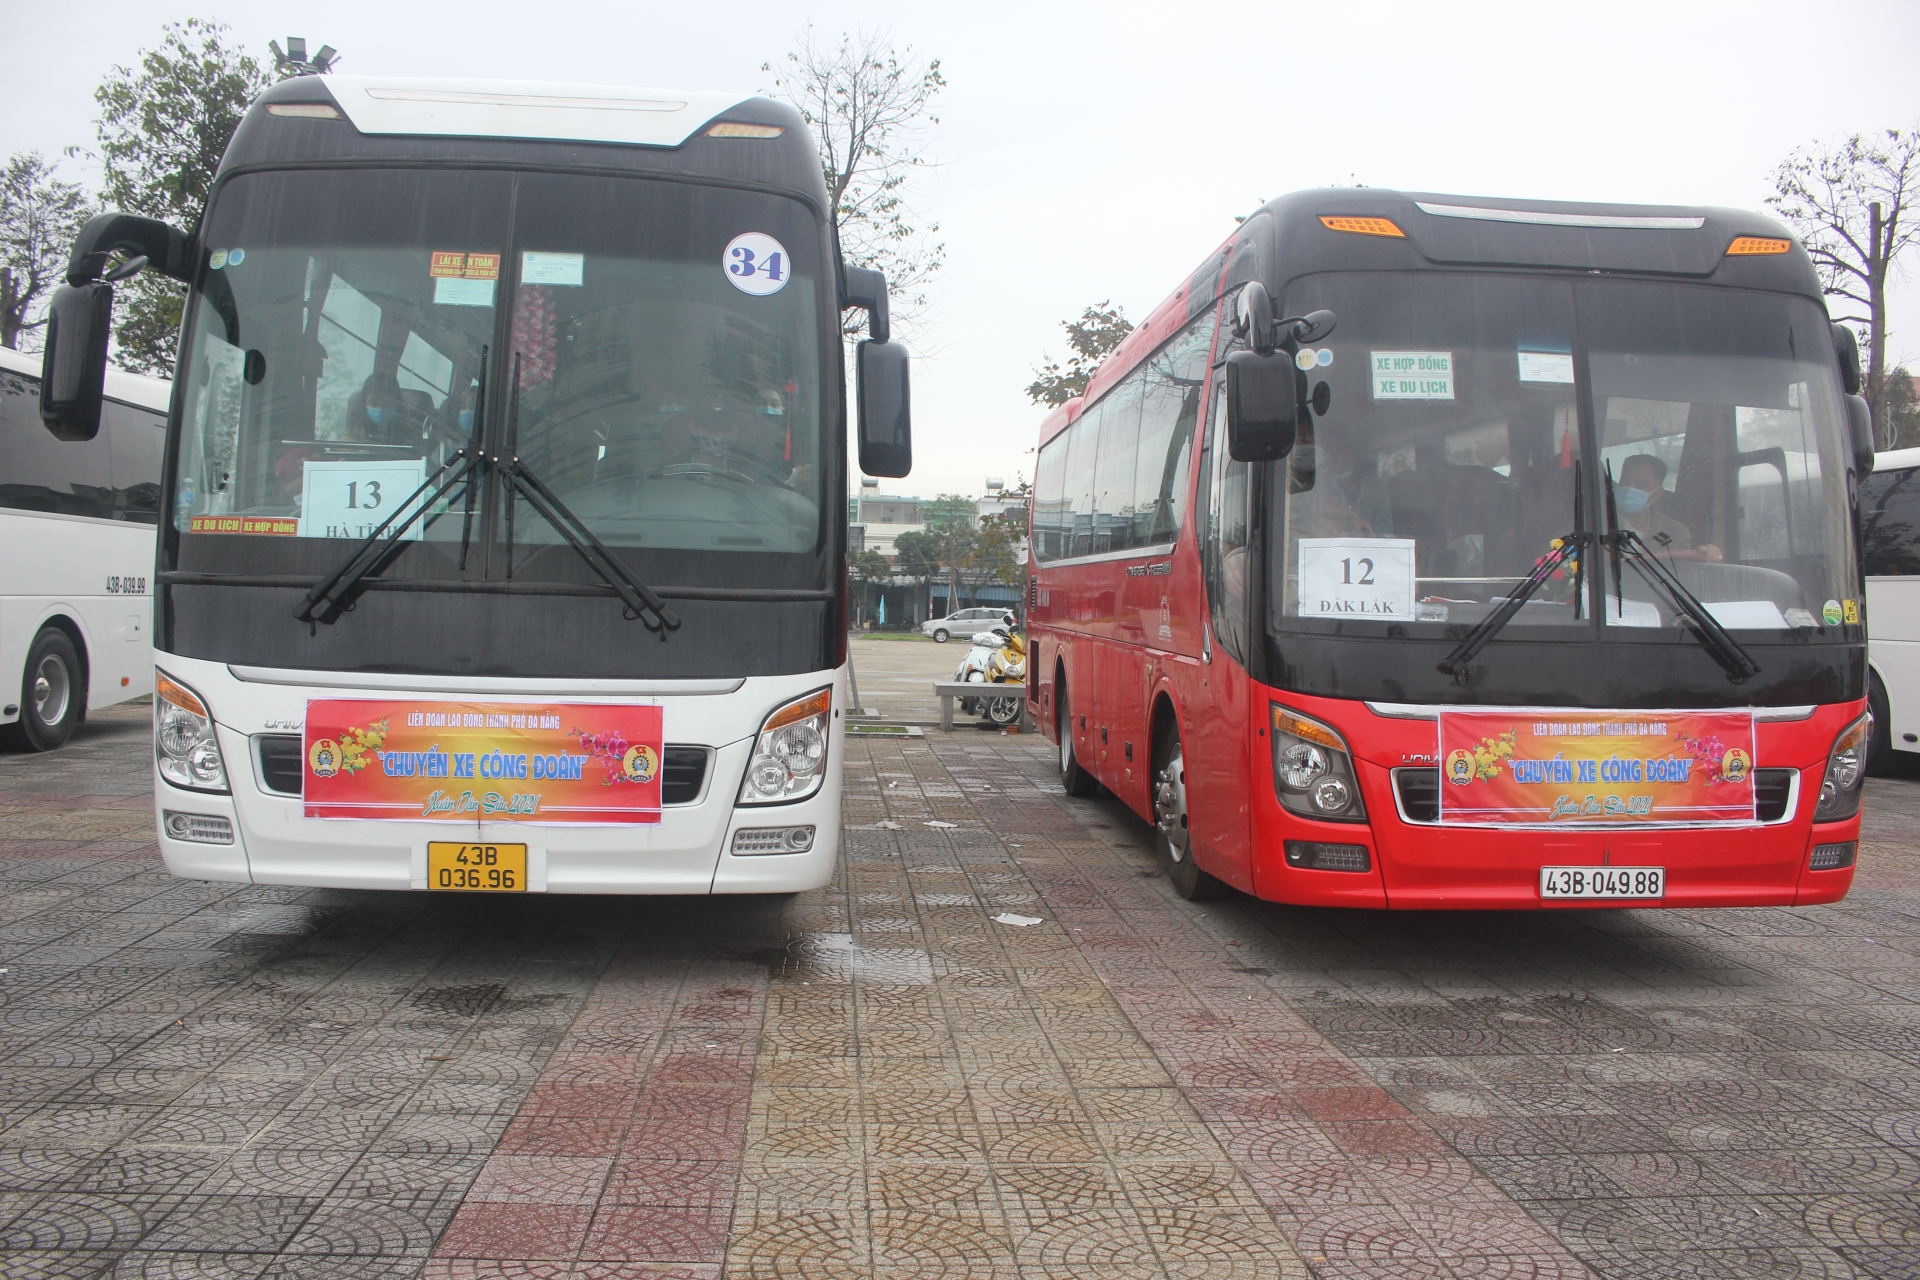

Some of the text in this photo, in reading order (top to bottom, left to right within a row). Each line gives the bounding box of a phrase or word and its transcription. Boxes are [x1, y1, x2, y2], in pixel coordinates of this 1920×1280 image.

[452, 256, 462, 266] XE
[475, 256, 494, 268] TOÀN
[730, 246, 784, 282] 34
[1377, 357, 1391, 371] XE
[1394, 356, 1415, 373] HỢP
[1380, 380, 1447, 396] XE DU LỊCH
[345, 480, 382, 509] 13
[192, 519, 239, 532] XE DU LỊCH
[243, 521, 254, 532] XE
[254, 521, 271, 533] HỢP
[326, 521, 350, 538] HÀ
[1340, 557, 1375, 585] 12
[106, 576, 146, 594] 43B-039.99
[407, 709, 561, 730] LIÊN ĐOÀN LAO ĐỘNG THÀNH PHỐ ĐÀ NẴNG
[1533, 718, 1667, 739] LIÊN ĐOÀN LAO ĐỘNG THÀNH PHỐ ĐÀ NẴNG
[452, 753, 476, 778] XE
[479, 748, 528, 779] CÔNG
[1576, 759, 1597, 783] XE
[1600, 755, 1641, 783] CÔNG
[422, 790, 455, 816] Xuân
[456, 790, 479, 814] Tân
[507, 793, 541, 815] 2021
[1549, 794, 1580, 819] Xuân
[1580, 794, 1601, 817] Tân
[1625, 795, 1654, 816] 2021
[456, 846, 498, 866] 43B
[439, 868, 515, 889] 036.96
[1545, 871, 1660, 895] 43B-049.88
